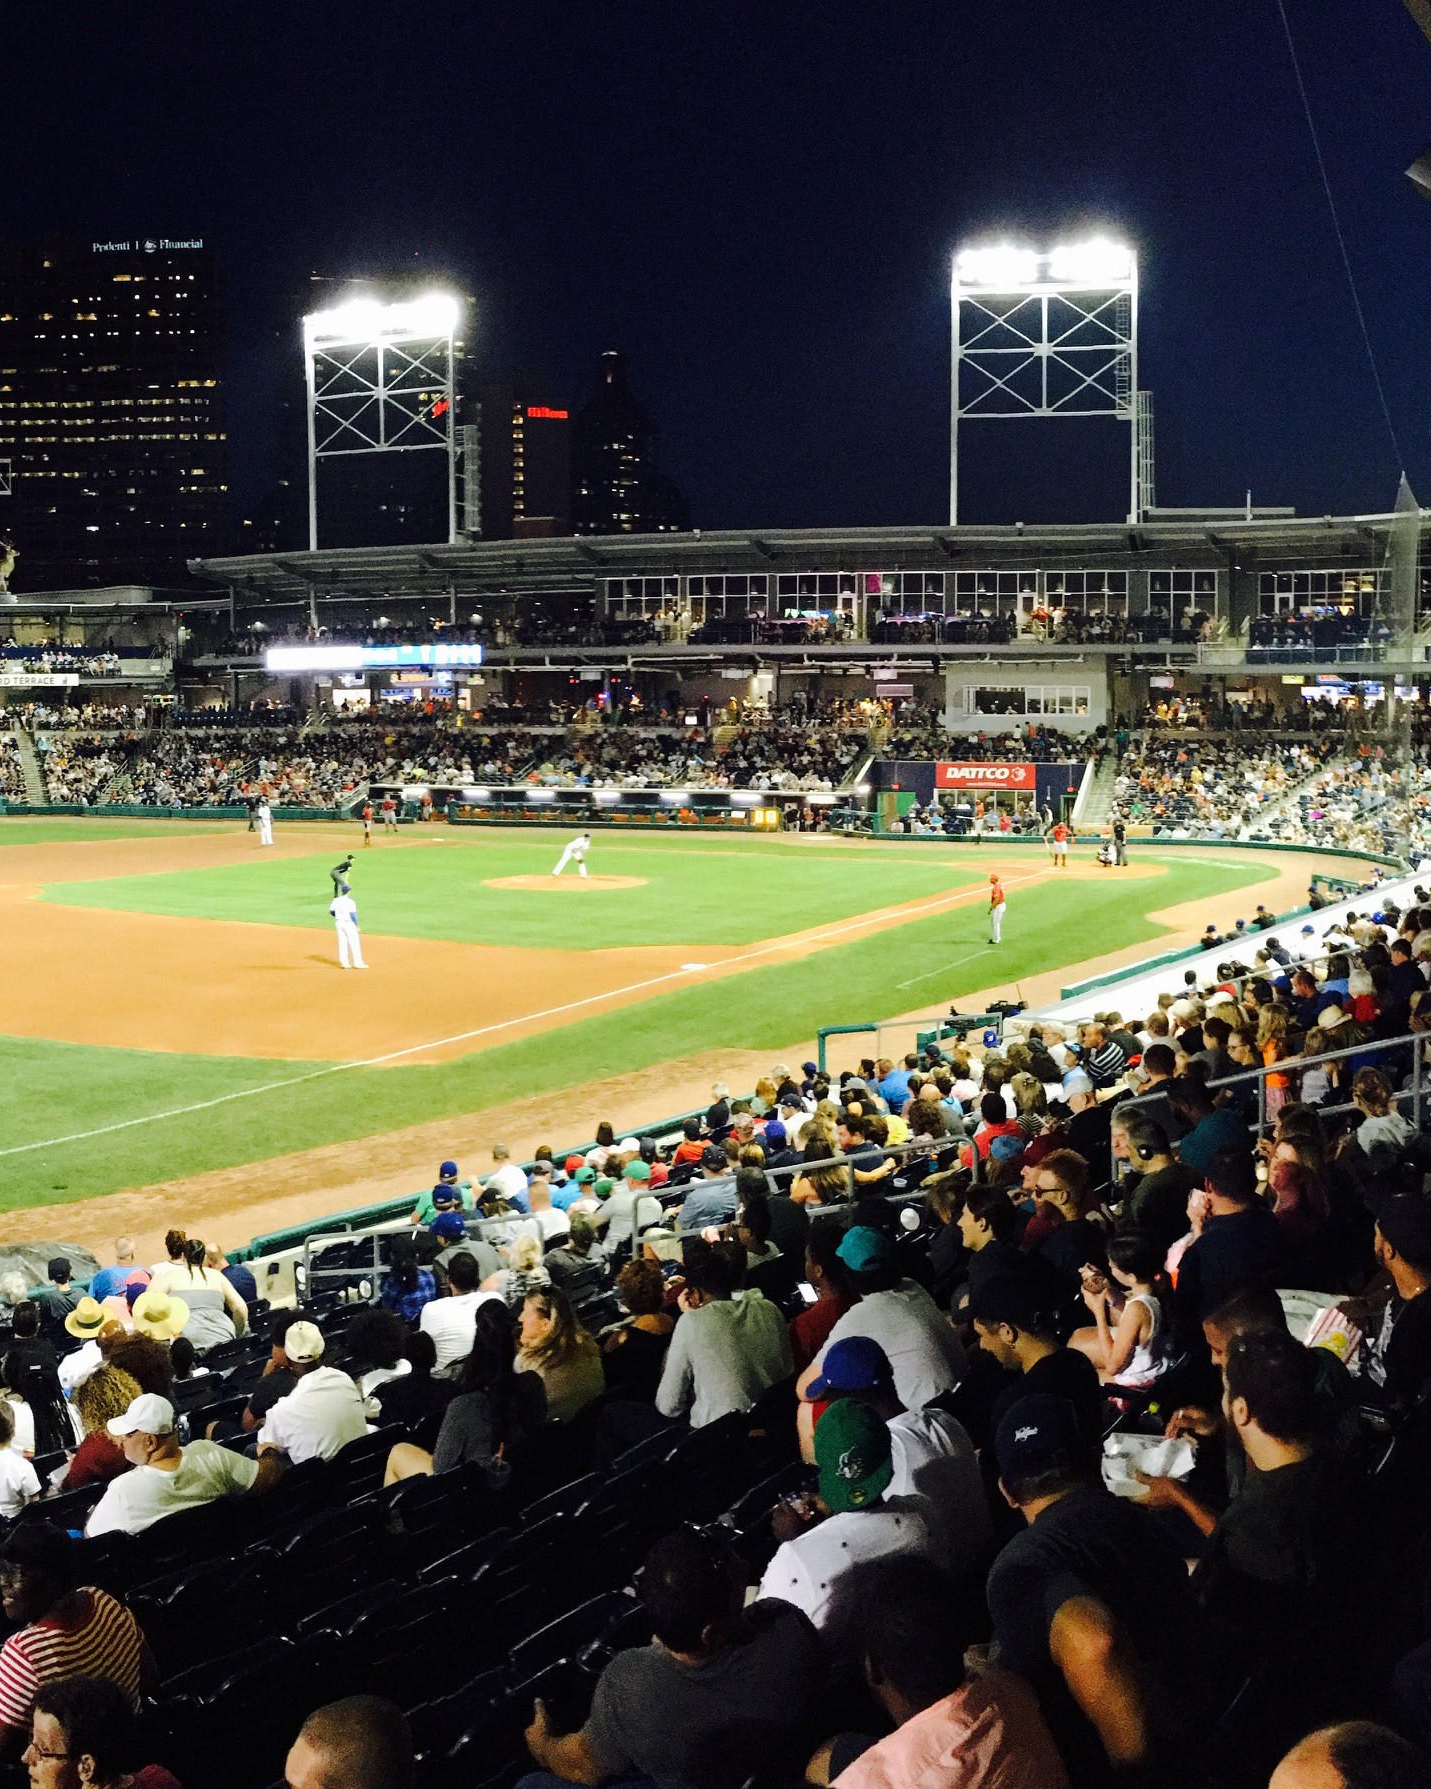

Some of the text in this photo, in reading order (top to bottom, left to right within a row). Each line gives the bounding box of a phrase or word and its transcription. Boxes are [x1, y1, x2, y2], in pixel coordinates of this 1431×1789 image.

[159, 239, 204, 249] Financial
[13, 677, 55, 685] TERRACE
[946, 767, 1010, 779] DATTCO
